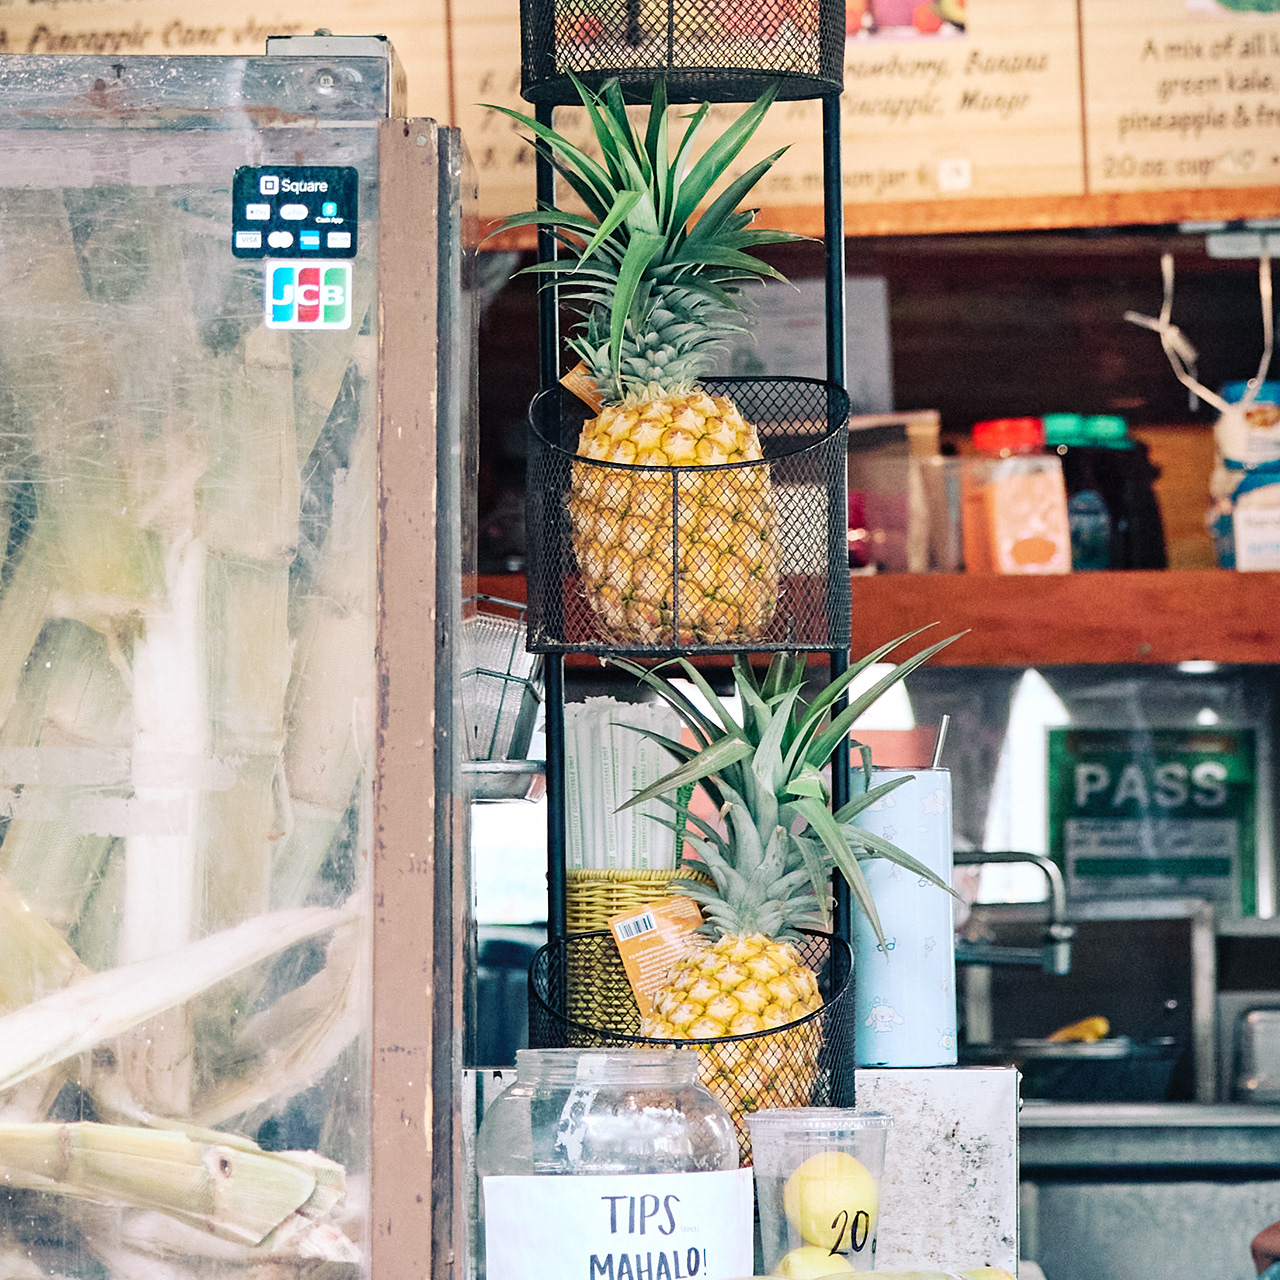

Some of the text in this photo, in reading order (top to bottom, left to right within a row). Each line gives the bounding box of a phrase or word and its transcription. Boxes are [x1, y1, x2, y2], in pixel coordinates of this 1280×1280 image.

[281, 179, 328, 195] Square
[1074, 761, 1229, 808] PASS
[601, 1194, 680, 1236] TIPS
[590, 1247, 707, 1280] MAHALO!
